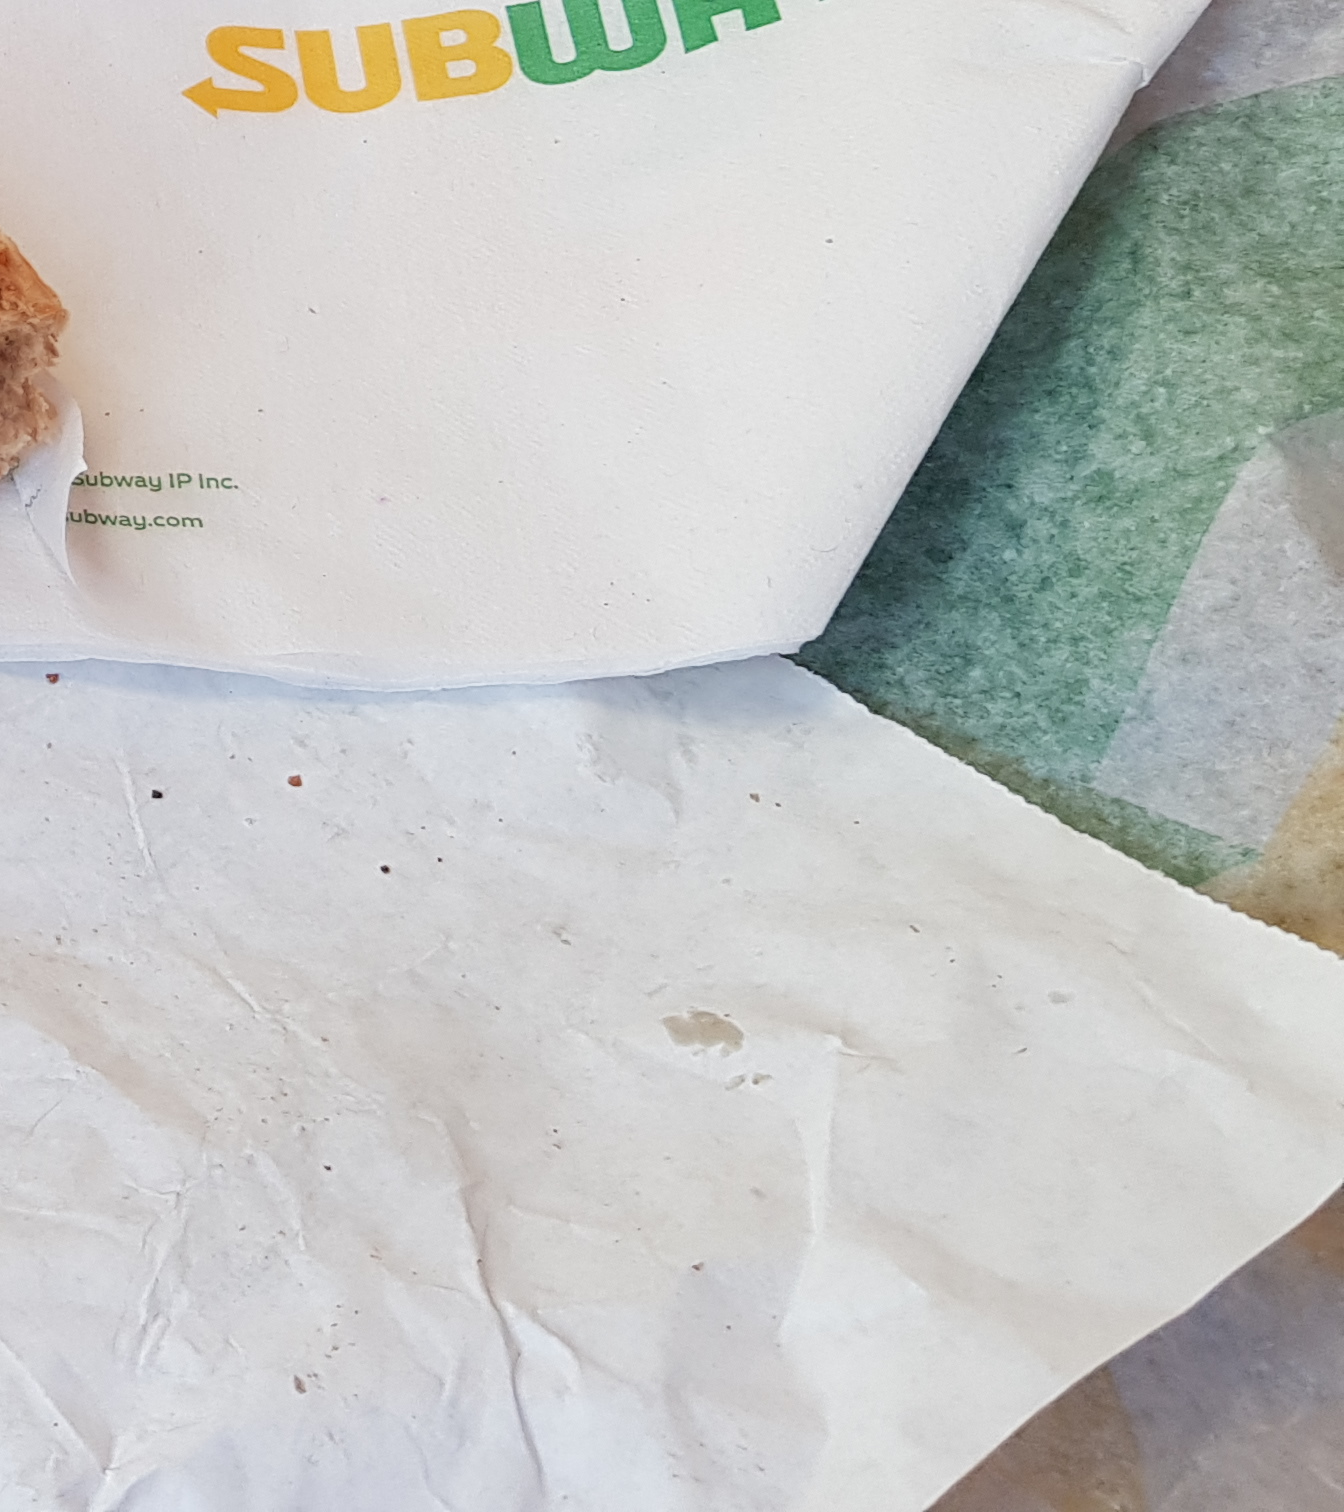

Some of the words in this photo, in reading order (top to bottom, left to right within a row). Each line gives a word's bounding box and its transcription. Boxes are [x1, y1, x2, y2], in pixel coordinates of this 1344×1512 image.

[169, 472, 192, 489] IP
[199, 473, 239, 489] Inc.
[65, 509, 204, 530] ubway.com
